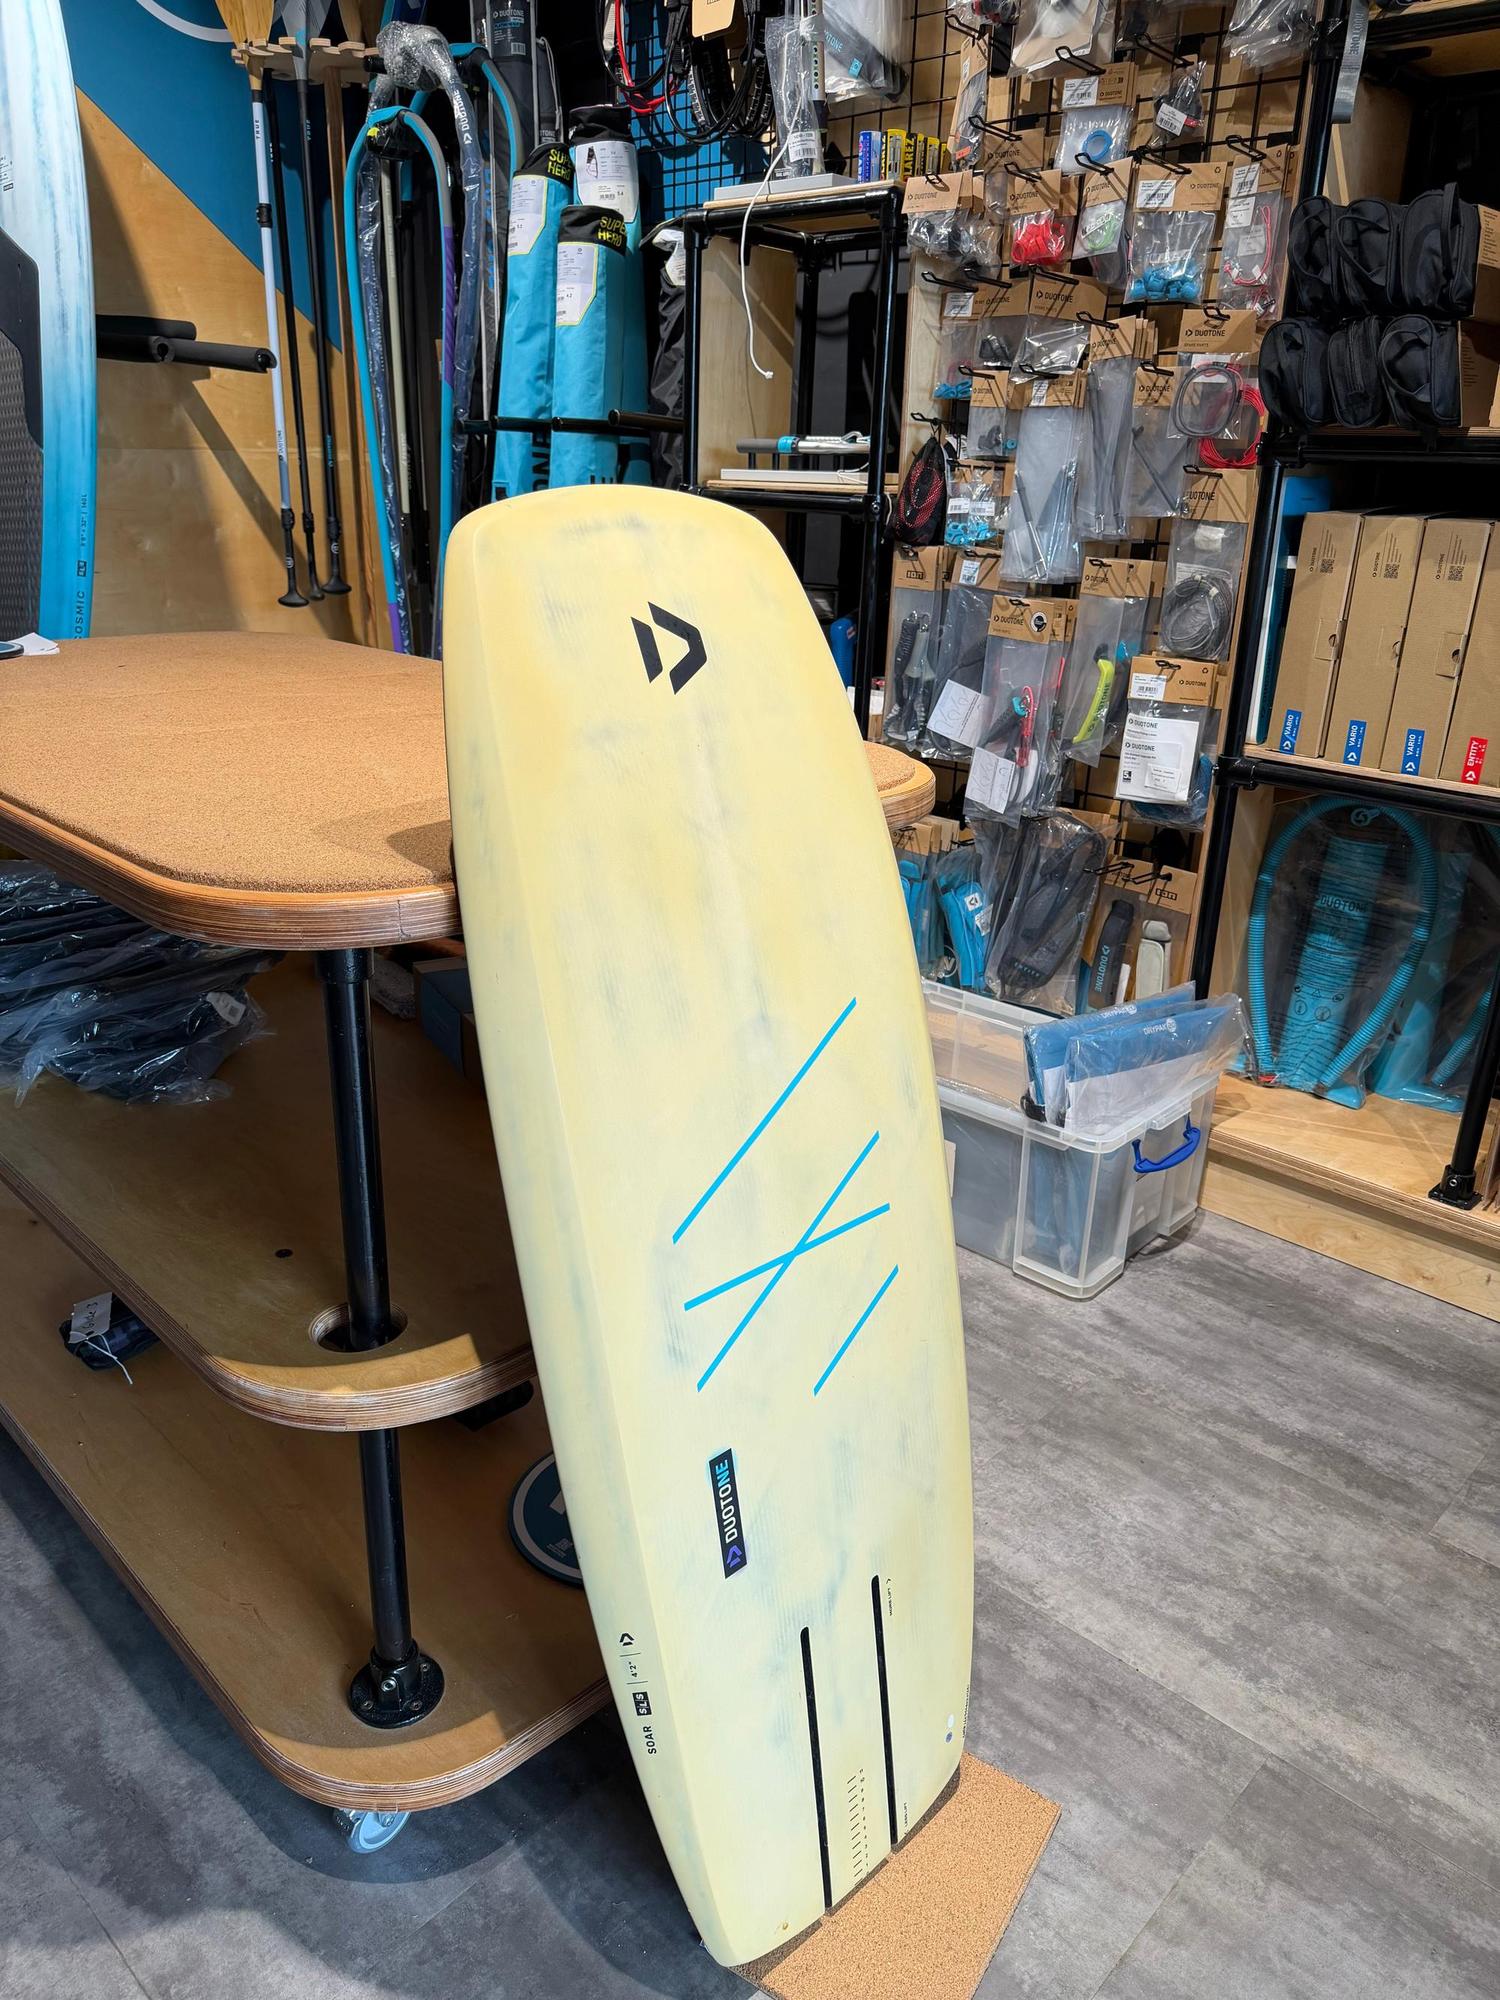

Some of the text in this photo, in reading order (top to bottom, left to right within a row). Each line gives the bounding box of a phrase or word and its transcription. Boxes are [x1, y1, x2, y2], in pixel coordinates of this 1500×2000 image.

[453, 89, 470, 132] DUOTONE
[254, 119, 262, 140] TRUE
[993, 149, 1021, 159] DUOTONE
[914, 191, 938, 200] DUOTONE
[597, 229, 623, 247] HERO
[1044, 291, 1074, 303] DUOTONE
[1194, 329, 1226, 337] DUOTONE
[1145, 385, 1171, 393] DUOTONE
[1000, 615, 1025, 626] DUOTONE
[1185, 680, 1207, 688] DUOTONE
[1134, 719, 1158, 729] DUOTONE
[1283, 714, 1294, 736] VARIO
[1348, 725, 1359, 746] VARIO
[1131, 743, 1155, 752] DUOTONE
[1406, 734, 1417, 756] VARIO
[1466, 740, 1480, 767] ENTITY
[1094, 955, 1108, 993] DUOTONE
[1143, 1023, 1168, 1035] DRYPAK
[715, 1459, 738, 1544] DUOTONE
[628, 1661, 657, 1755] SOAR SLS 4'2"
